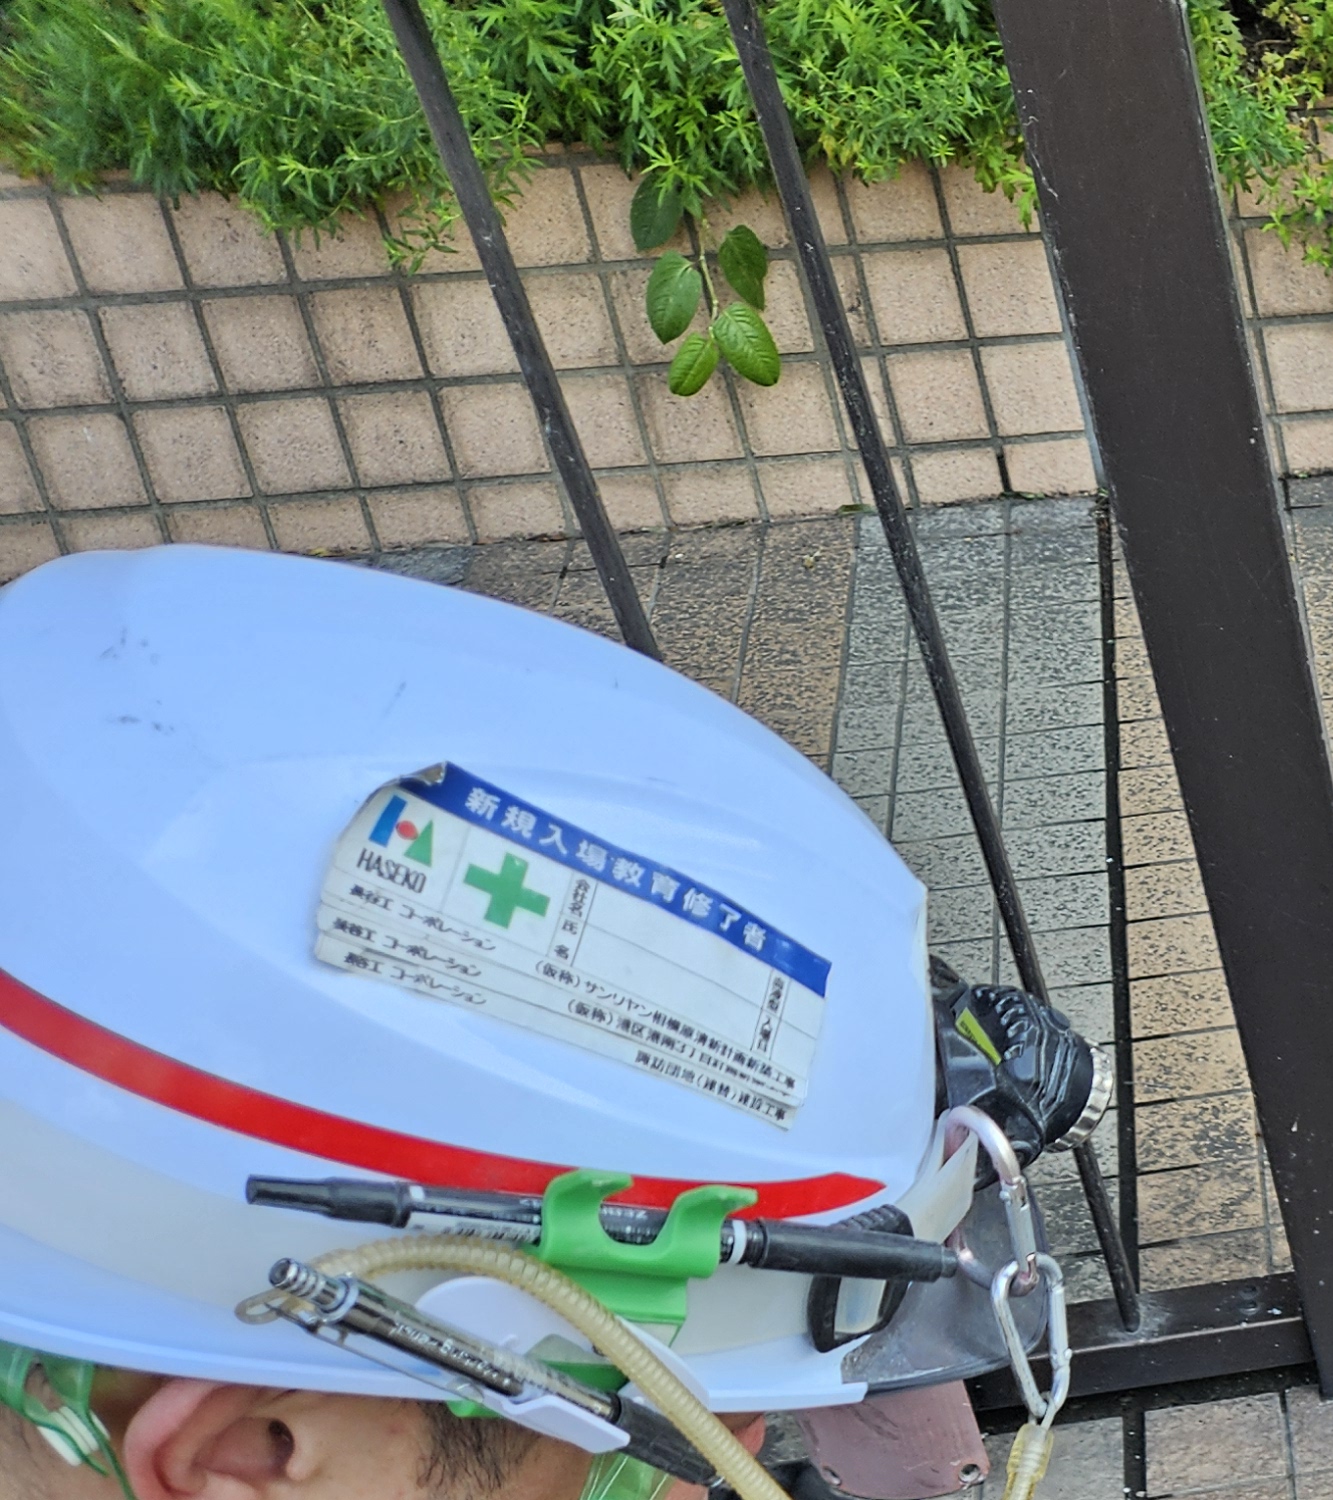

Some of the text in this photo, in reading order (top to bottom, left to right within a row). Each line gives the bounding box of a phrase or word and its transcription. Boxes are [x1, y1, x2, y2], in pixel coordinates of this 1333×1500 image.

[356, 847, 428, 895] HASEKO
[464, 786, 768, 952] 新規入場教育修了者
